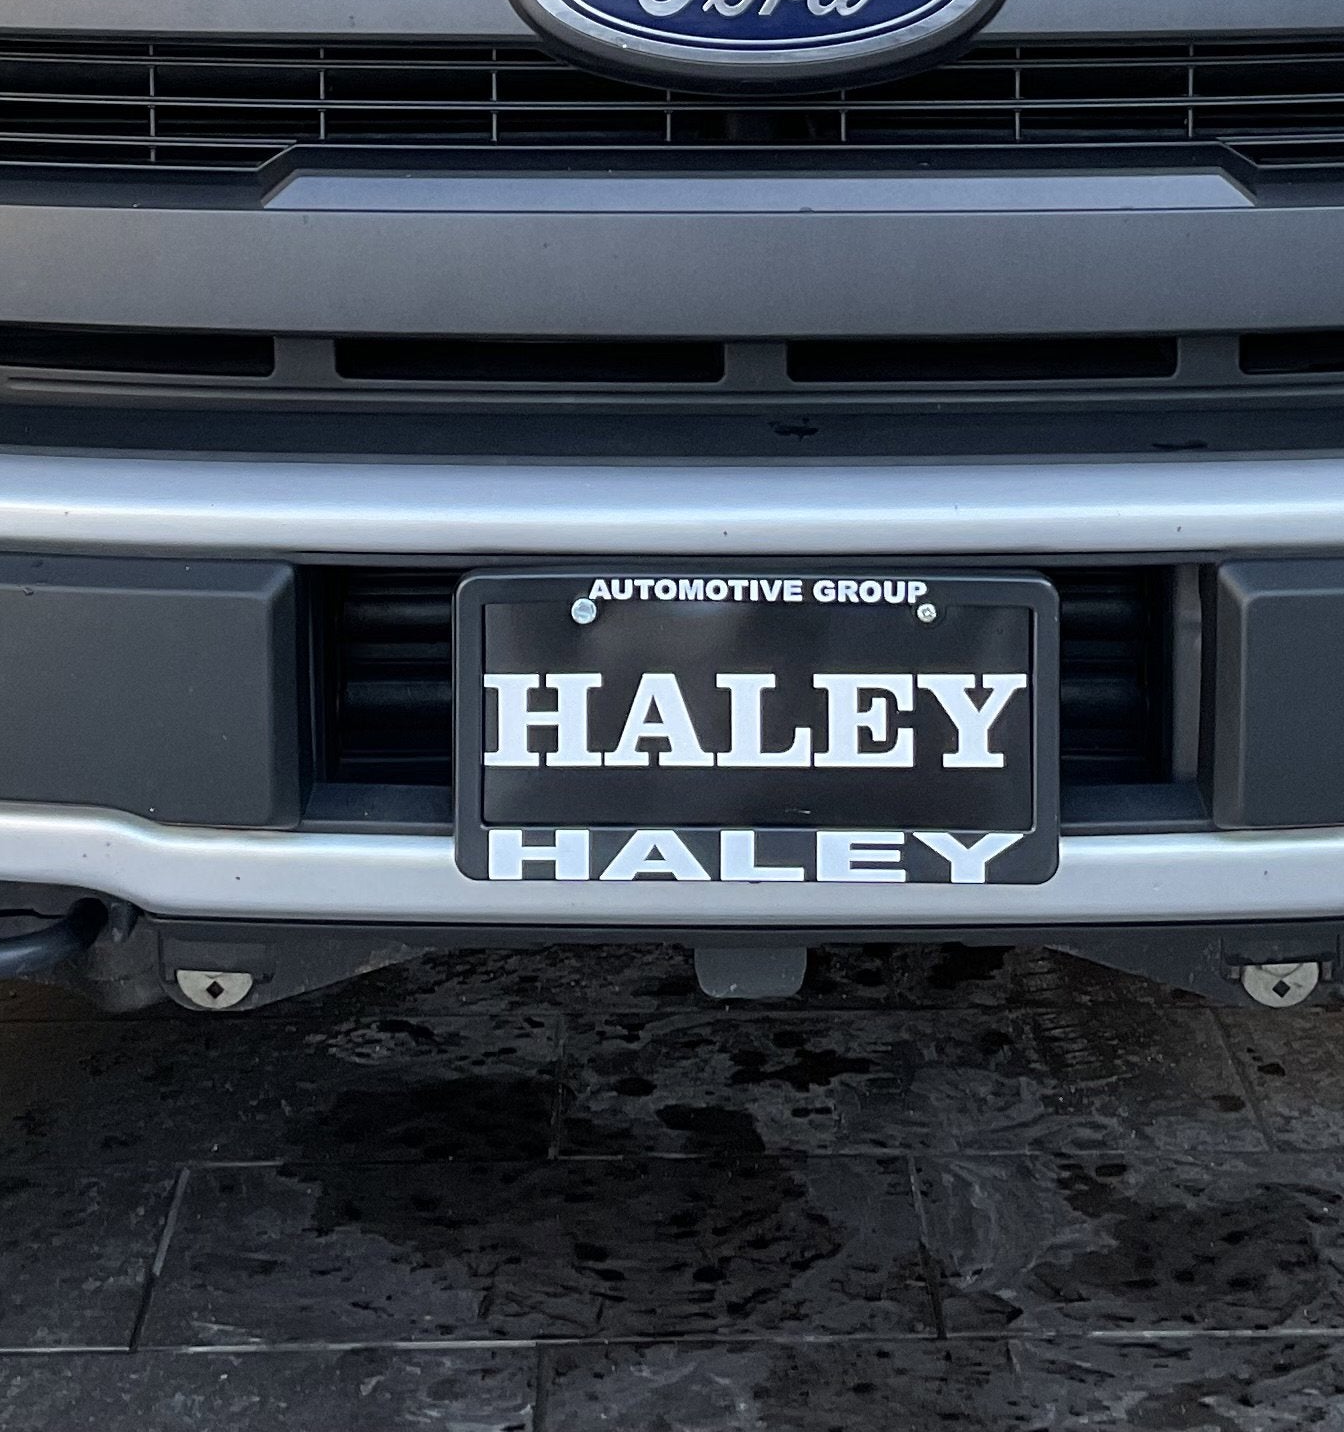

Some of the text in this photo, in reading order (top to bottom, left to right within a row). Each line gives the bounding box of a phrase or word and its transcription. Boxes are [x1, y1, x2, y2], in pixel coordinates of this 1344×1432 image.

[589, 579, 928, 603] AUTOMOTIVE GROUP
[483, 673, 1027, 768] HALEY
[488, 829, 1024, 884] HALEY
